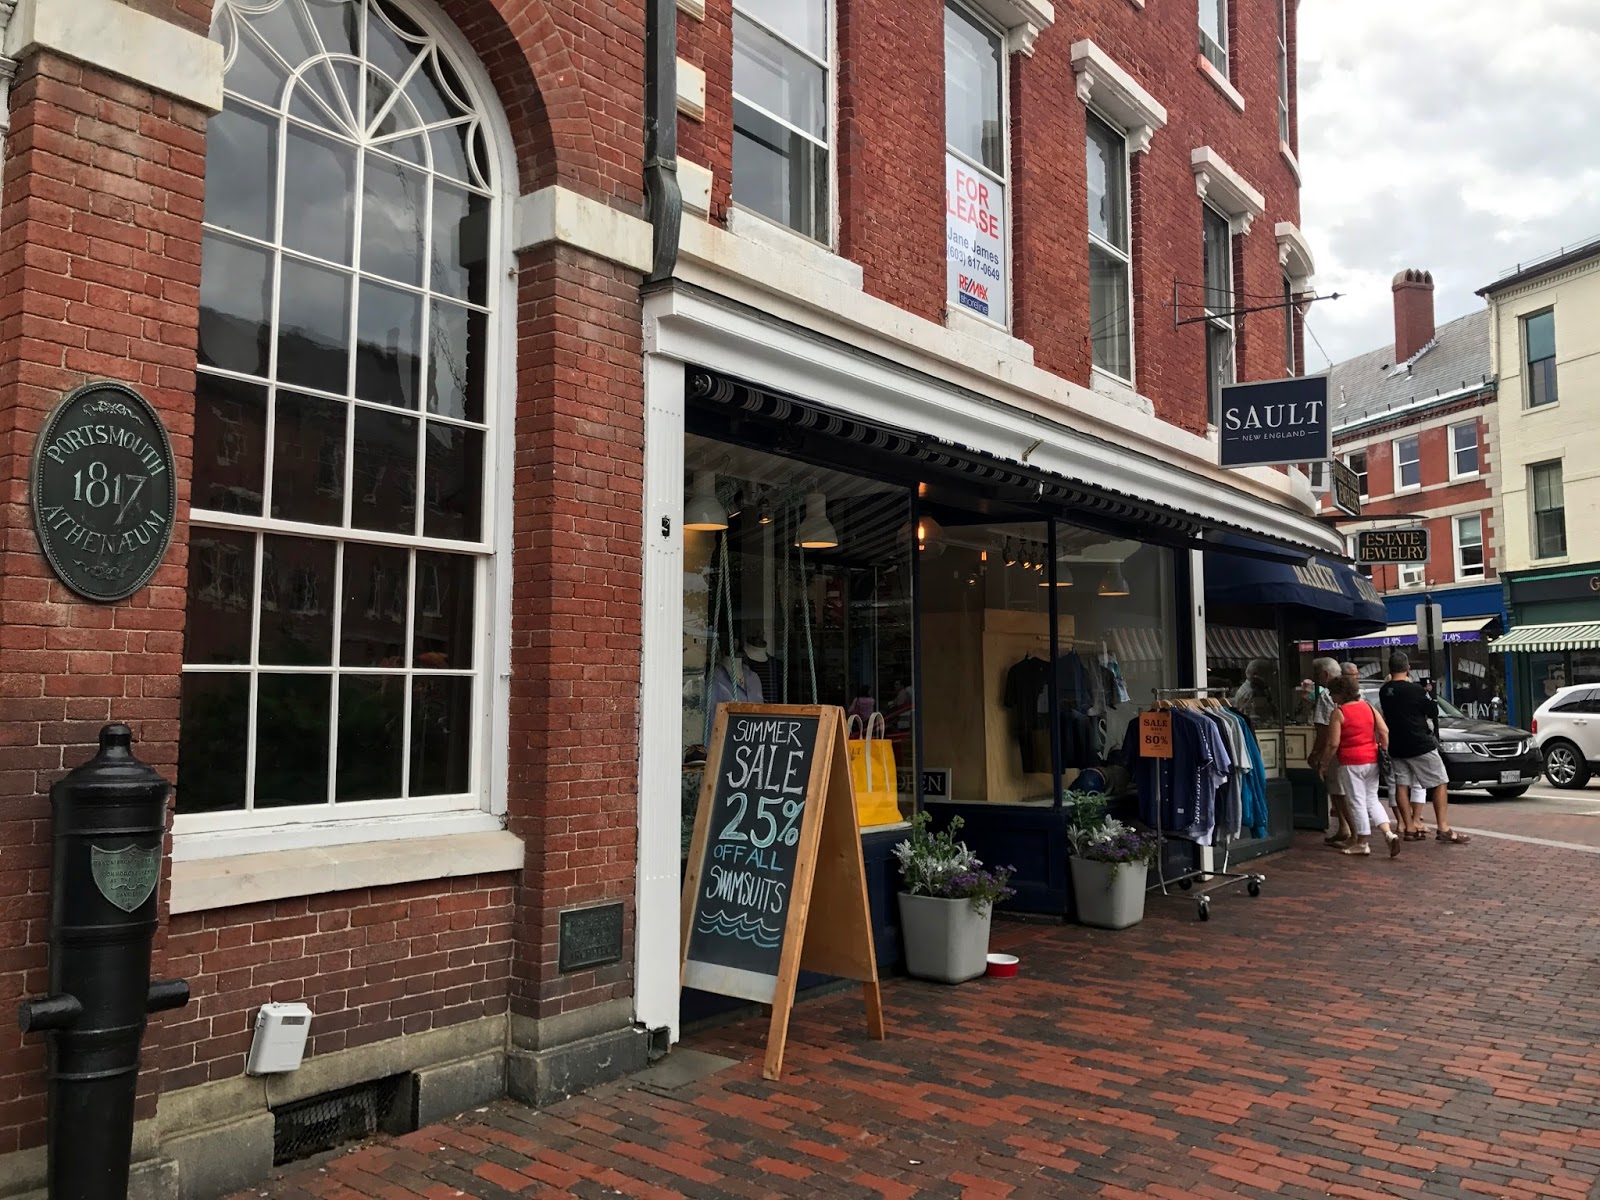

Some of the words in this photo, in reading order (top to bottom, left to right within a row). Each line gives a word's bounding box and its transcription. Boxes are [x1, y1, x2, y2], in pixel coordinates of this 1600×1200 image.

[956, 169, 989, 210] FOR
[946, 190, 999, 240] LEASE
[948, 227, 969, 249] Jane
[971, 240, 999, 265] James
[948, 244, 966, 267] (603)
[967, 255, 1000, 281] 817-0649
[959, 273, 989, 301] RE/MAX
[960, 294, 988, 314] shoreline
[1225, 401, 1323, 430] SAULT
[1264, 430, 1306, 440] ENGLAND
[47, 425, 166, 477] PORTSMOUTH
[73, 461, 147, 525] 1817
[1360, 546, 1426, 560] JEWELRY
[1366, 532, 1420, 546] ESTATE
[733, 719, 802, 747] SUMMER
[1144, 719, 1168, 727] SALE
[1145, 735, 1168, 745] 80%
[726, 744, 804, 794] SALE
[718, 792, 805, 848] 25%
[714, 845, 744, 863] OFF
[745, 848, 784, 872] ALL
[705, 865, 786, 913] SWIMSUITS
